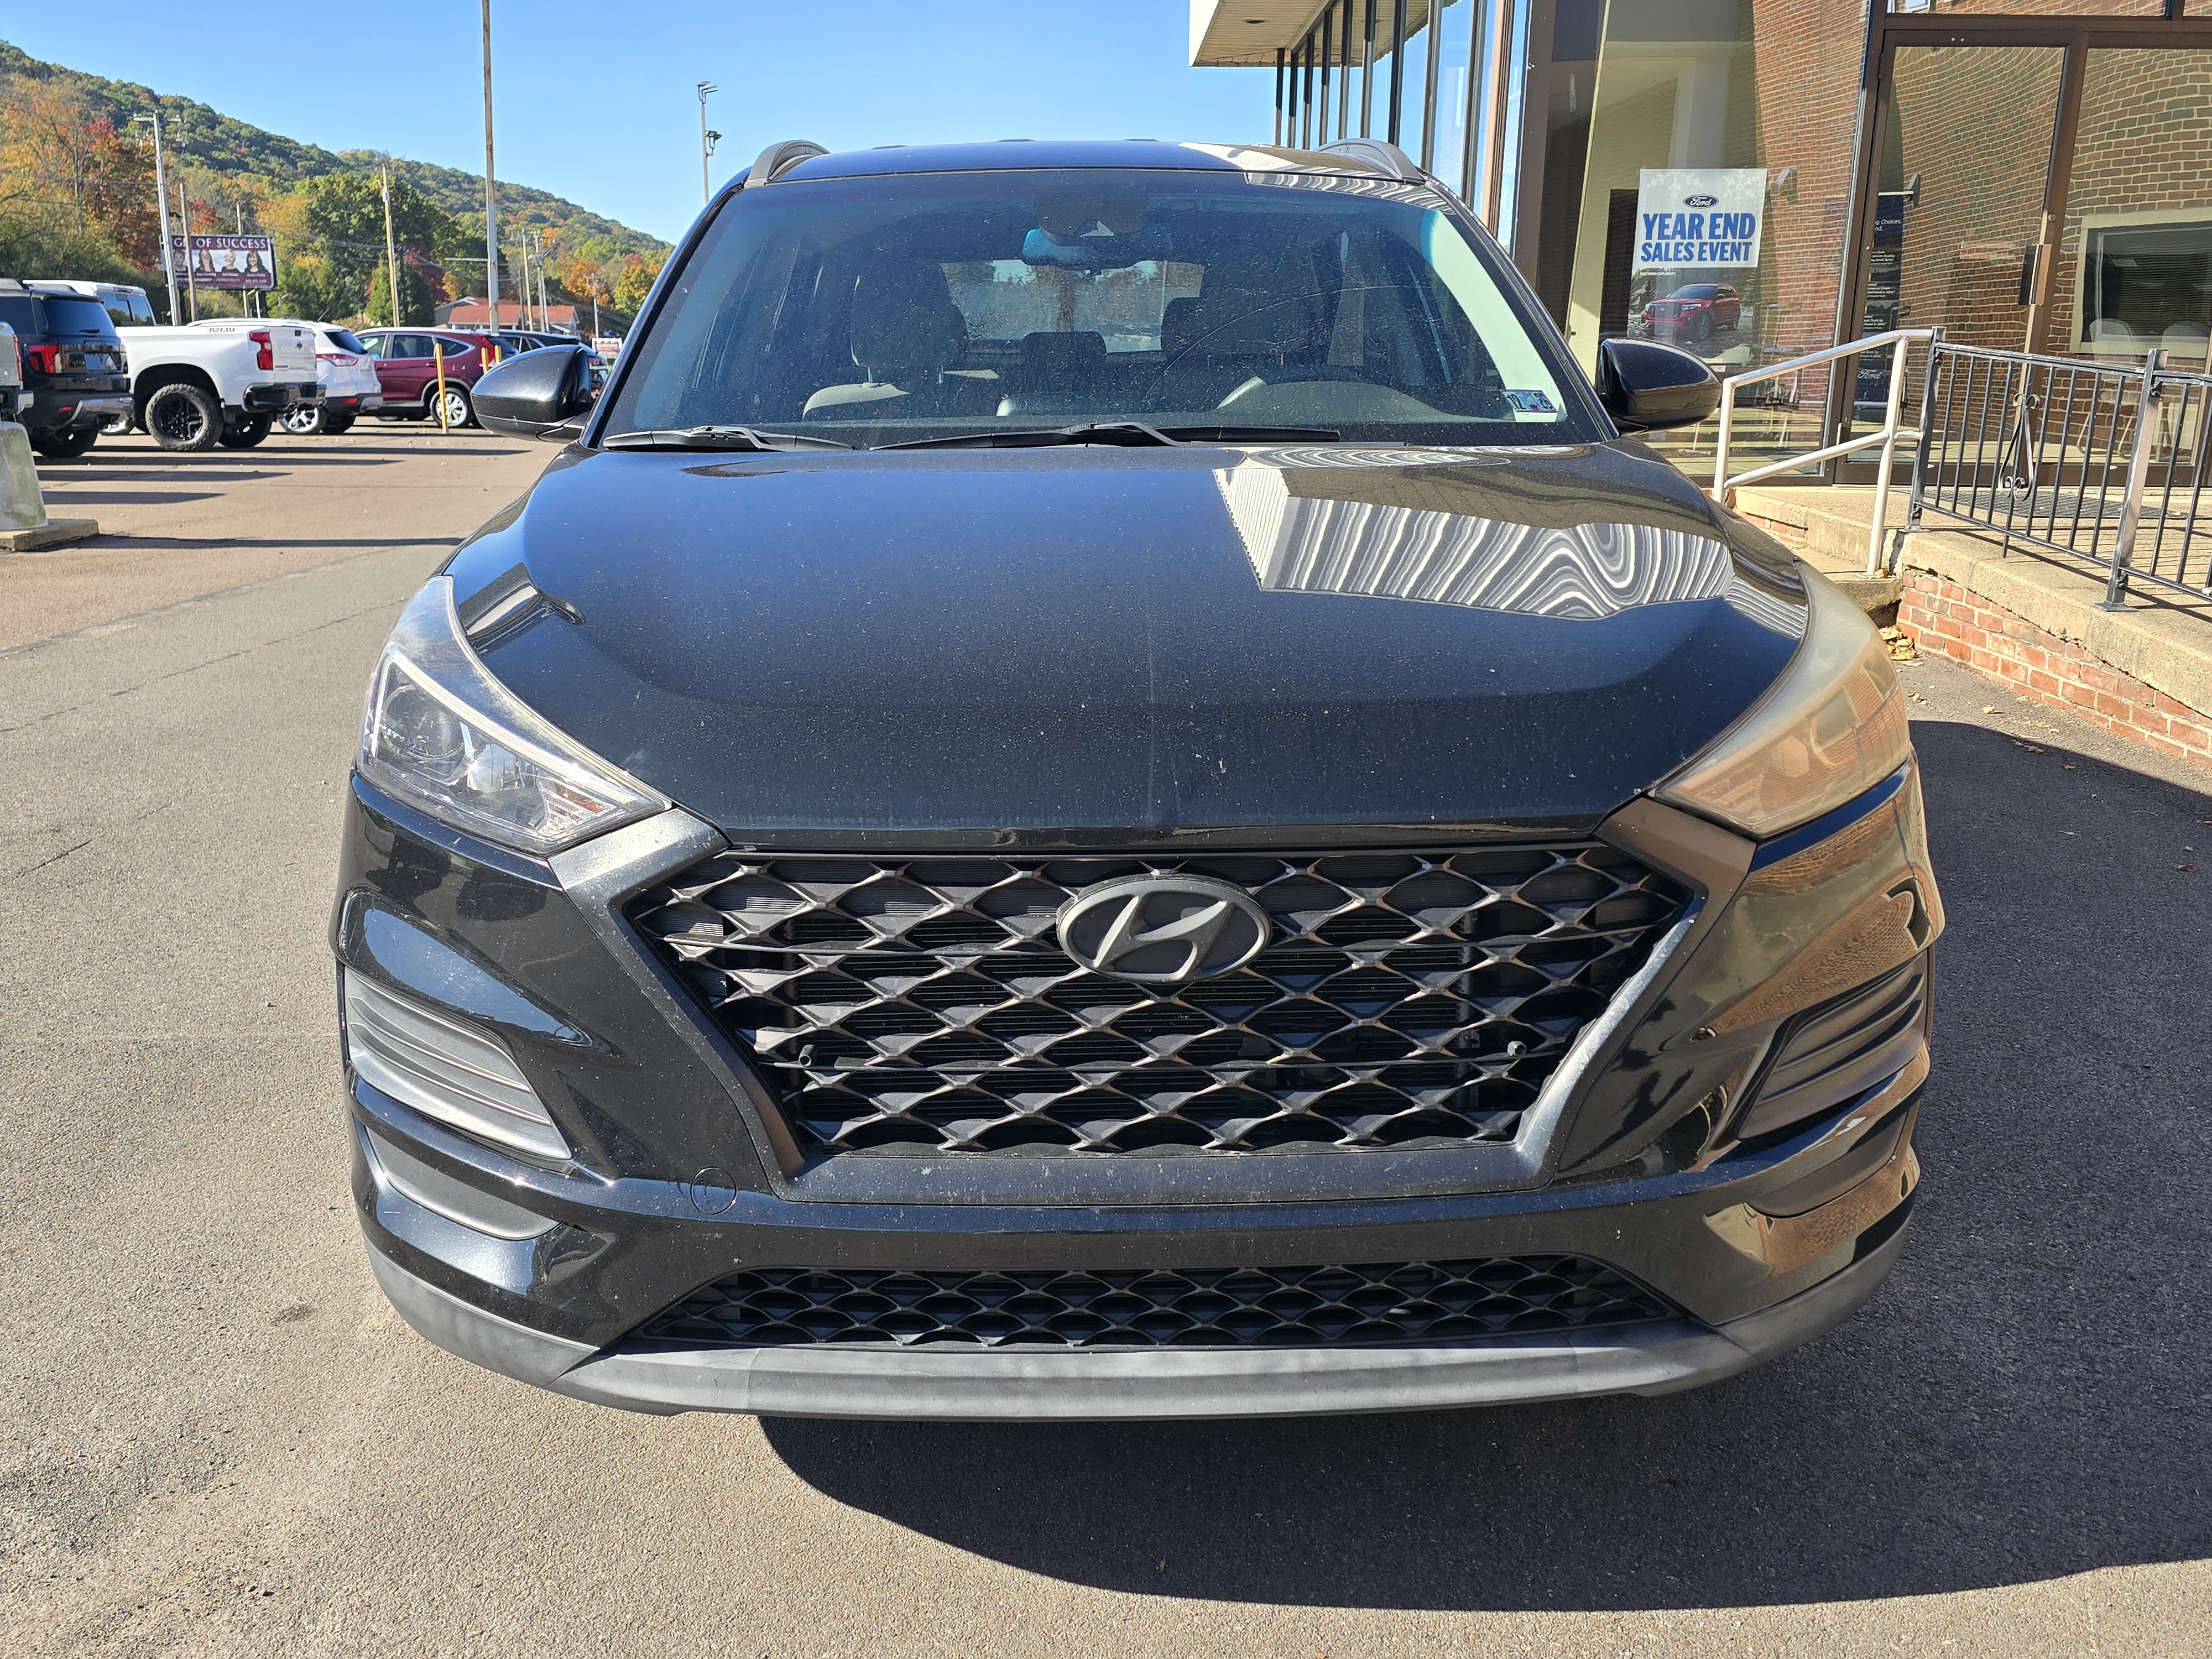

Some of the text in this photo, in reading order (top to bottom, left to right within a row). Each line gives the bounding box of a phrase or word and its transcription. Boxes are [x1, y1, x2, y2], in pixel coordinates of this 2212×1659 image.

[1690, 196, 1712, 206] Ford
[1642, 212, 1756, 240] YEAR END
[196, 238, 211, 248] OF
[216, 237, 266, 249] SUCCESS
[1641, 242, 1752, 262] SALES EVENT
[1858, 369, 1882, 379] Ford
[1506, 394, 1527, 410] 12
